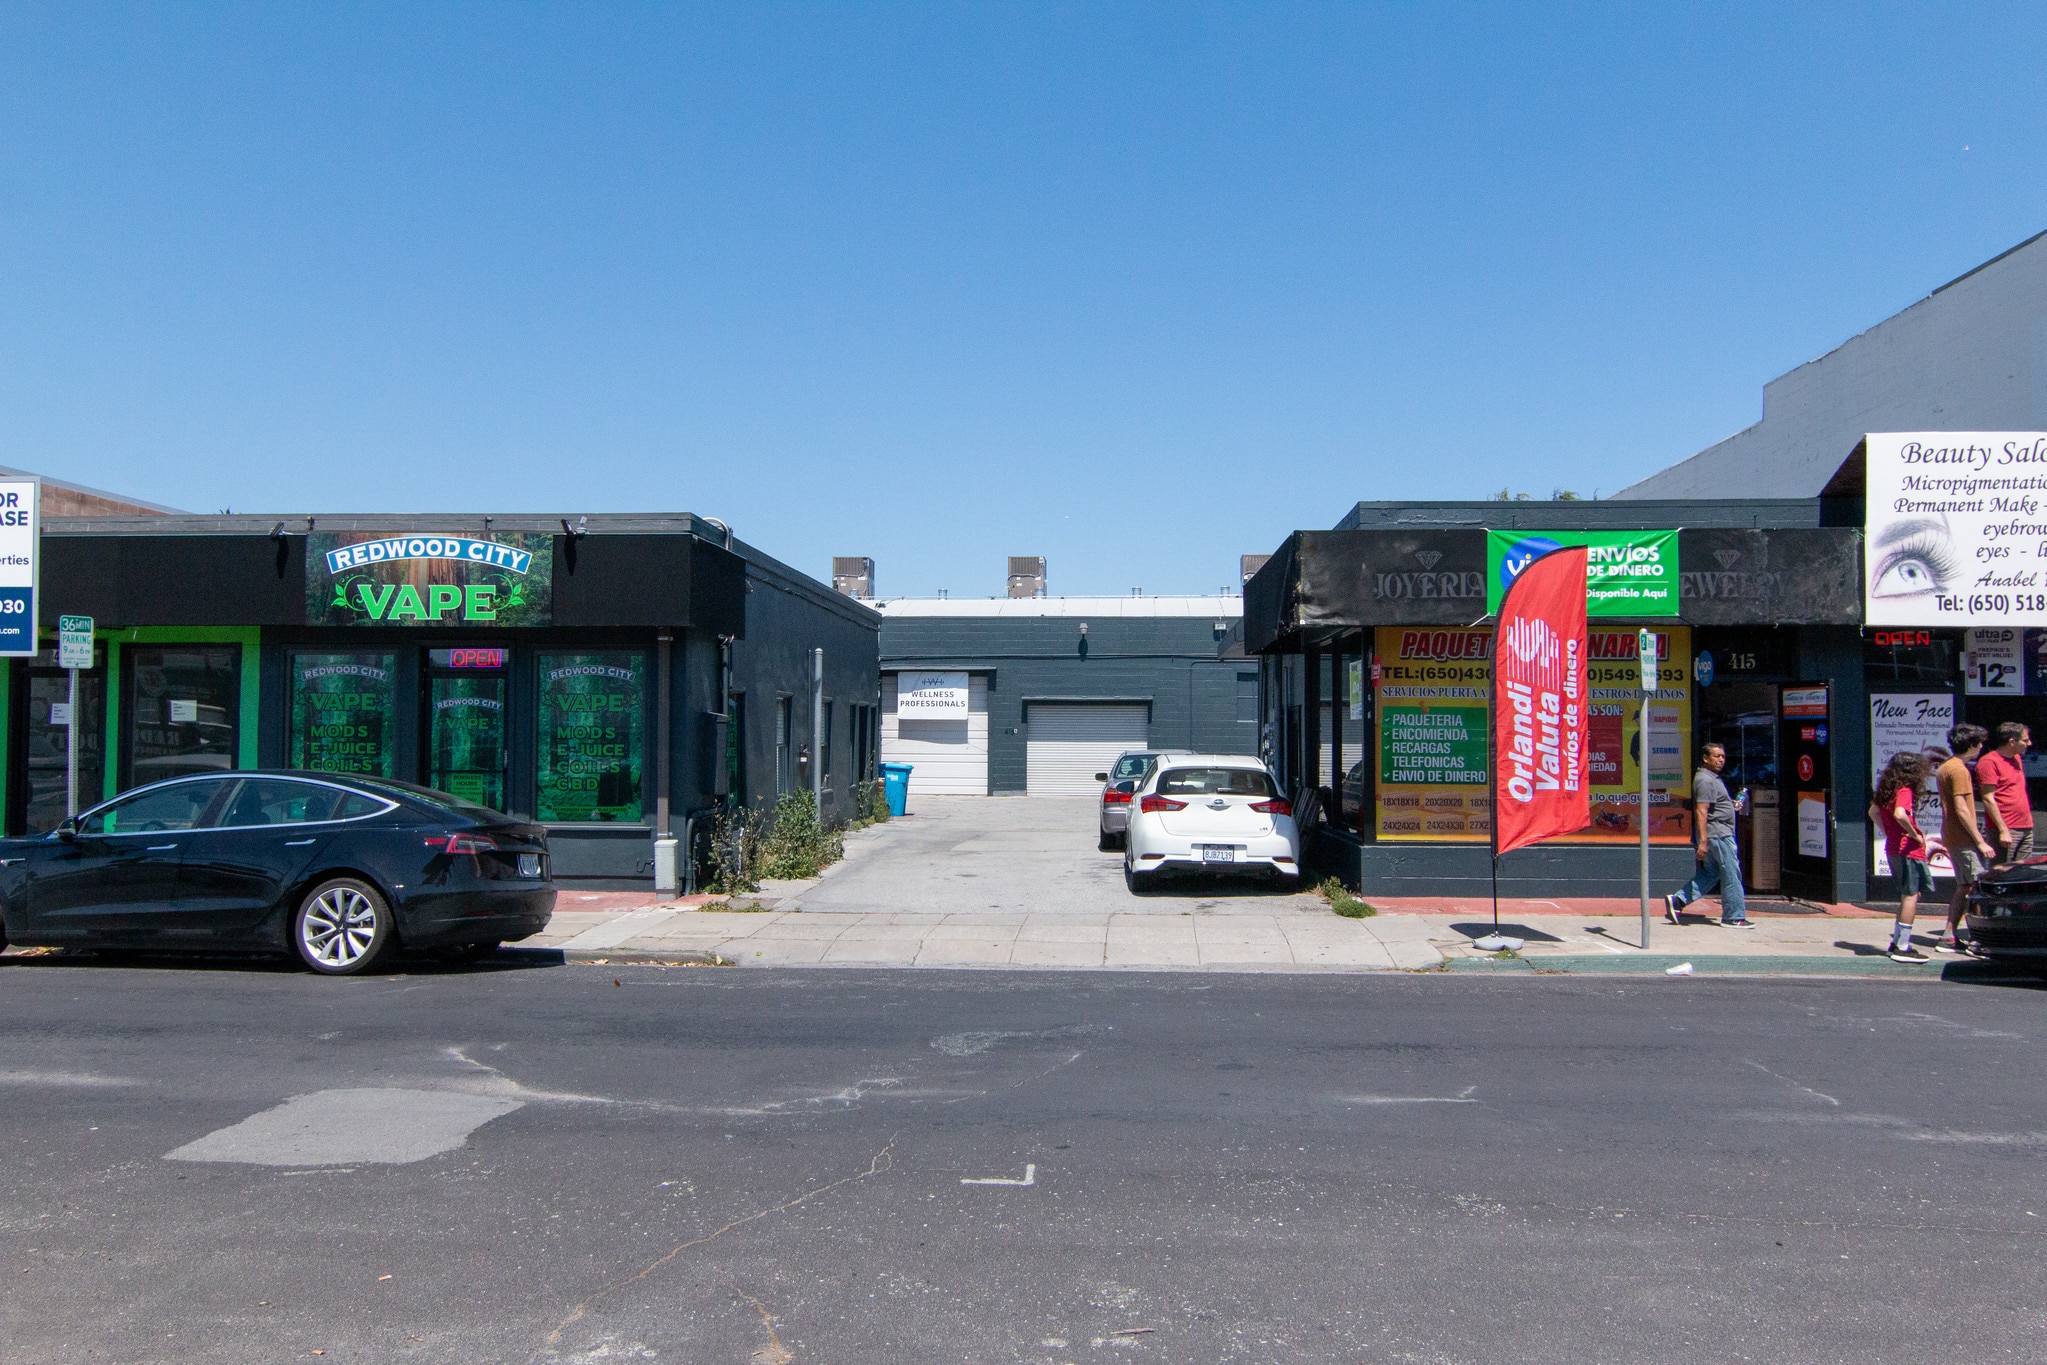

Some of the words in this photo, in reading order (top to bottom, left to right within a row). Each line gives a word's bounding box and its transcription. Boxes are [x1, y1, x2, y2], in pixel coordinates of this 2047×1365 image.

[1900, 442, 1992, 471] Beauty
[1894, 498, 1984, 512] Permanent
[1989, 495, 2038, 516] Make
[334, 539, 461, 569] REDWOOD
[468, 540, 527, 569] CITY
[1587, 543, 1660, 562] ENVÍOS
[1976, 546, 2010, 563] eyes
[1587, 565, 1604, 576] DE
[1609, 564, 1664, 576] DINERO
[1372, 572, 1487, 598] JOYERIA
[1974, 570, 2037, 588] Anabel
[1587, 589, 1640, 600] Disponible
[1643, 589, 1667, 599] Aquí
[357, 584, 496, 620] VAPE
[1935, 595, 1963, 611] Tel:
[1968, 594, 2009, 614] (650)
[2015, 594, 2047, 611] 518
[62, 619, 75, 631] 36
[76, 620, 90, 630] MIN
[62, 634, 91, 644] PARKING
[1875, 631, 1930, 646] OPEN
[1974, 629, 2000, 639] ultra
[453, 650, 499, 666] OPEN
[1728, 653, 1756, 669] 415
[305, 666, 358, 679] REDWOOD
[361, 666, 385, 679] CITY
[551, 667, 604, 680] REDWOOD
[608, 668, 633, 680] CITY
[1563, 639, 1579, 699] dinero
[1978, 663, 2005, 687] 12
[1382, 687, 1436, 697] SERVICIOS
[1440, 688, 1478, 698] PUERTA
[1480, 688, 1486, 698] A
[1634, 689, 1685, 699] DSTINOS
[310, 693, 376, 711] VAPE
[437, 699, 480, 709] REDWOOD
[482, 700, 502, 709] CITY
[556, 694, 624, 711] VAPE
[1563, 704, 1578, 727] de
[1600, 704, 1624, 717] SON:
[1872, 698, 1908, 718] New
[1915, 699, 1953, 721] Face
[445, 718, 489, 729] VAPE
[1392, 714, 1463, 726] PAQUETERIA
[310, 725, 368, 737] MODS
[557, 727, 616, 739] MODS
[1392, 728, 1468, 740] ENCOMIENDA
[1507, 681, 1533, 803] Orlandi
[1535, 691, 1560, 790] Valuta
[1392, 742, 1451, 754] RECARGAS
[310, 759, 372, 771] COILS
[556, 761, 620, 773] COILS
[1392, 756, 1464, 768] TELEFONICAS
[1563, 732, 1579, 791] Envíos
[1392, 770, 1425, 782] ENVIO
[1428, 771, 1443, 782] DE
[1445, 771, 1486, 783] DINERO
[556, 778, 599, 791] CBD
[1382, 798, 1420, 806] 18X18X18
[1425, 798, 1462, 807] 20X20X20
[1608, 794, 1628, 803] que
[1383, 822, 1420, 830] 24X24X24
[1426, 821, 1465, 830] 24X24X30
